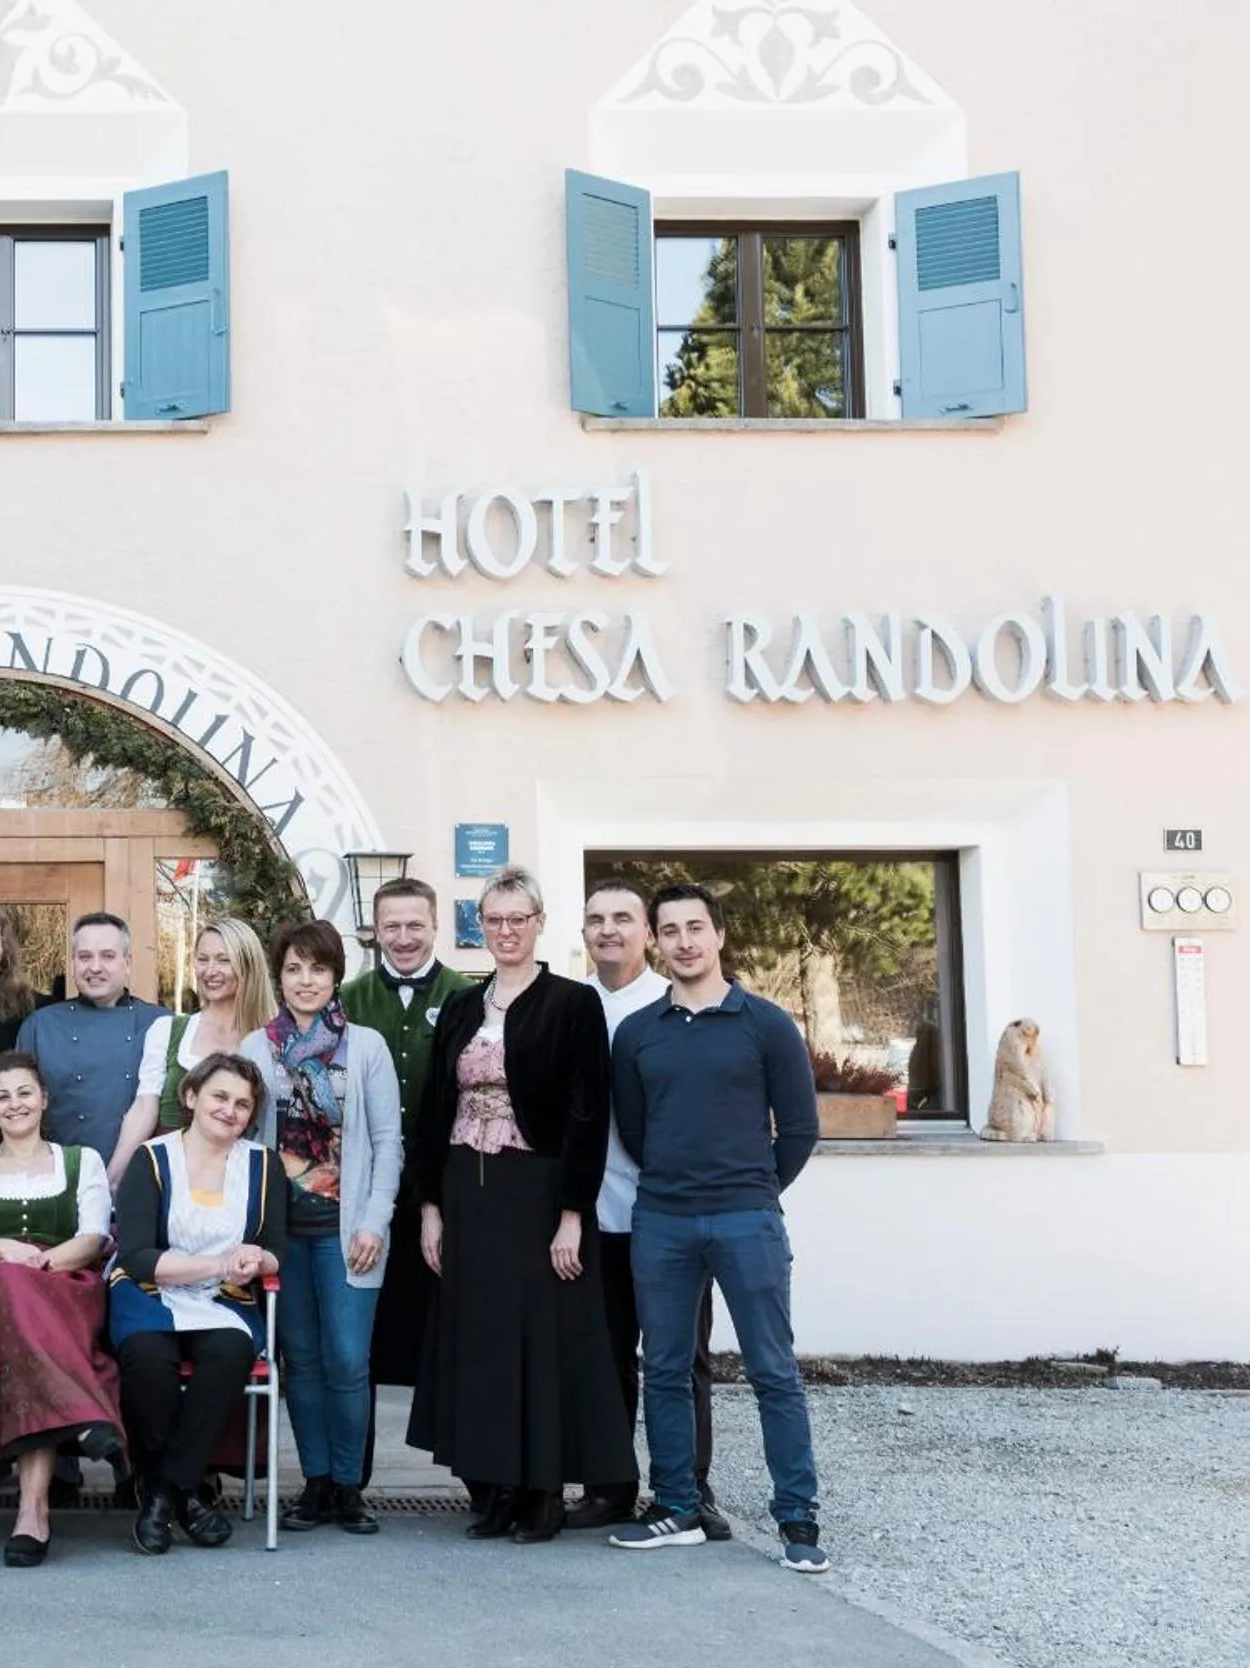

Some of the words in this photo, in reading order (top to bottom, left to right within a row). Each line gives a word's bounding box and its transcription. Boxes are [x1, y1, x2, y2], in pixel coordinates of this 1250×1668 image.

[402, 466, 671, 580] HOTEL
[399, 610, 679, 704] CHESA
[723, 592, 1245, 706] RANDOLINA
[1174, 831, 1196, 849] 40
